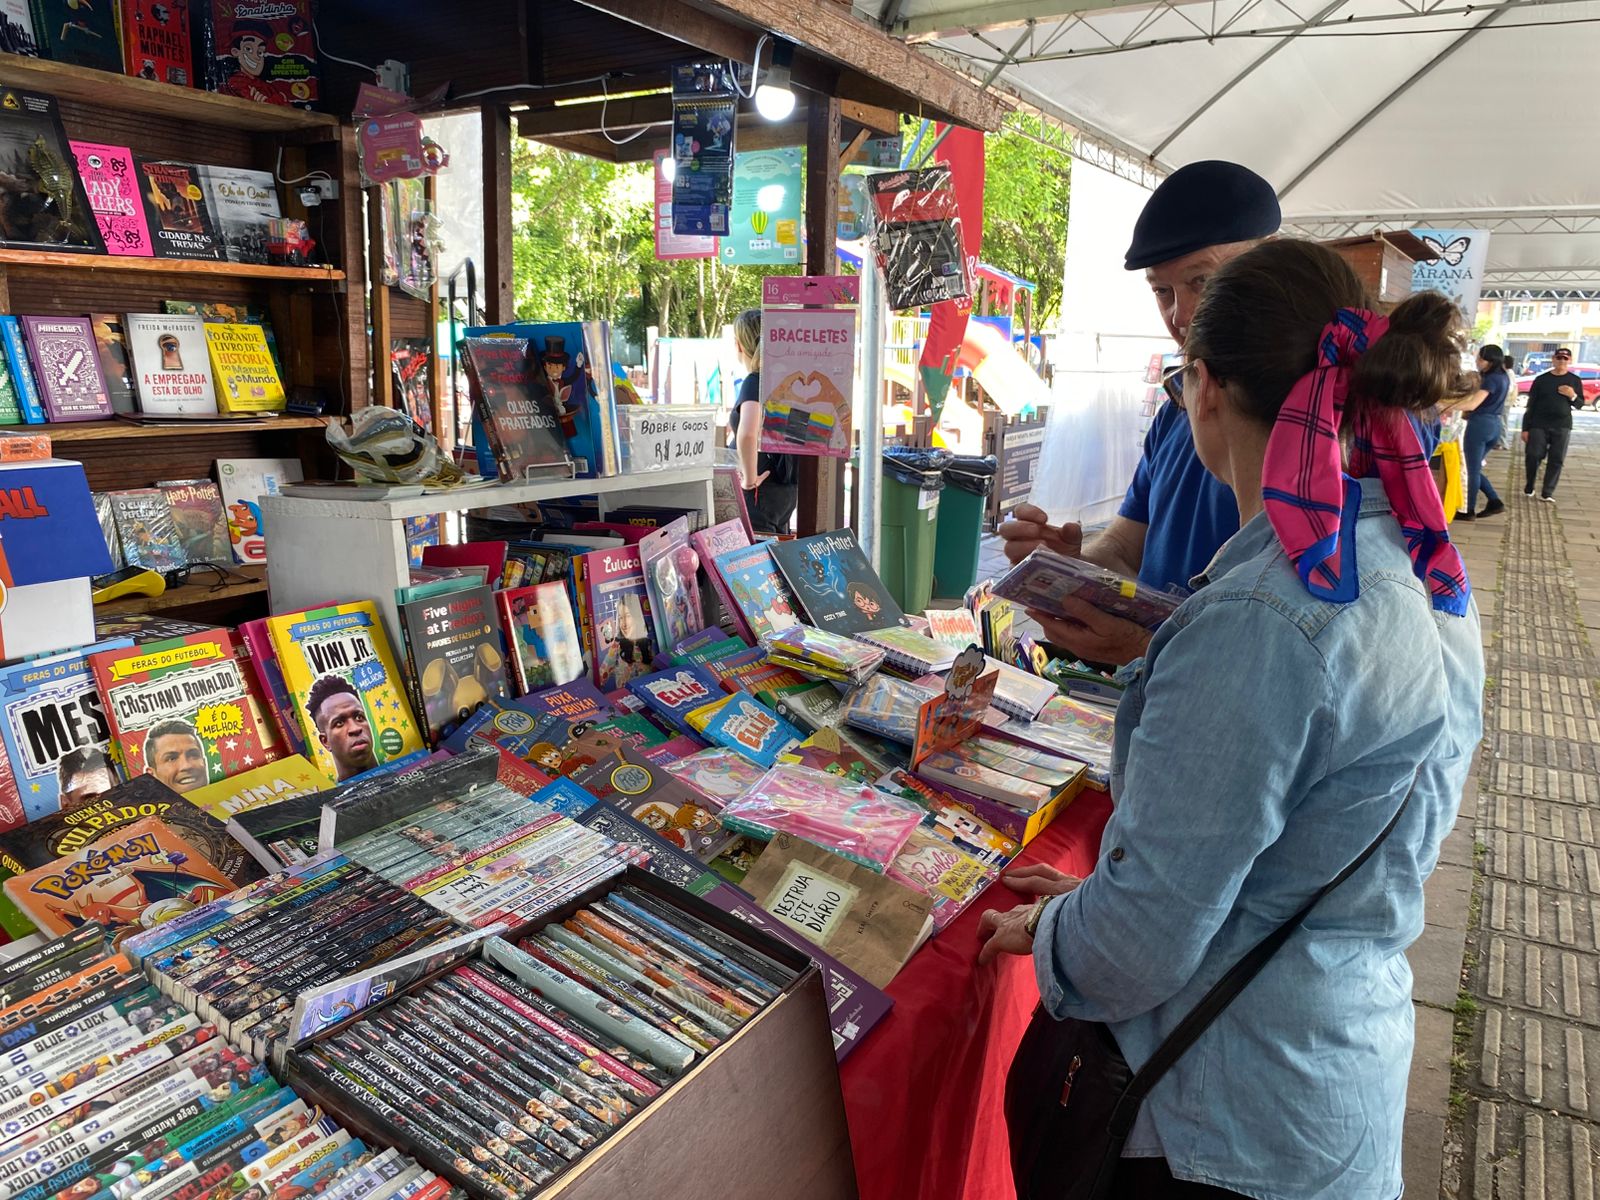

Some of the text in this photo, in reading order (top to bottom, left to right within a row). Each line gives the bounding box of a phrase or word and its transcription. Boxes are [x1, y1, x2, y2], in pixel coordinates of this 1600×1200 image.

[138, 25, 184, 48] RAPHAEL
[140, 41, 185, 63] MONTES
[81, 175, 121, 196] LADY
[158, 230, 212, 243] CIDADE NAS
[170, 239, 205, 250] TREVAS
[767, 283, 779, 296] 16
[38, 324, 83, 336] MINECRAFT
[213, 332, 261, 343] O GRANDE
[769, 328, 848, 344] BRACELETES
[214, 342, 258, 352] LIVRO DE
[218, 352, 270, 366] HISTÓRIA
[144, 374, 207, 385] A EMPREGADA
[232, 365, 270, 375] Manual
[242, 374, 277, 384] Mundo
[173, 385, 202, 395] DE OLHO
[507, 400, 541, 414] OLHOS
[499, 415, 556, 431] PRATEADOS
[641, 420, 677, 435] BOBBIE
[654, 440, 704, 461] R$ 20,00
[166, 486, 219, 506] Harry Potter
[806, 535, 854, 561] Harry Potter
[603, 552, 642, 574] Luluca
[422, 605, 447, 621] Five
[299, 617, 360, 633] FERAS DO FUTEBOL
[426, 624, 440, 636] at
[131, 648, 209, 670] FERAS DO FUTEBOL
[307, 637, 374, 674] VINI JR.
[23, 671, 50, 683] FERAS
[53, 667, 66, 676] DO
[358, 671, 384, 688] MELHOR
[367, 667, 373, 675] O
[119, 671, 235, 719] CRISTIANO RONALDO
[545, 690, 581, 707] PUXA,
[656, 682, 708, 707] ELLIE
[211, 710, 228, 723] É O
[563, 696, 597, 717] BRUXA!
[203, 718, 239, 734] MELHOR
[737, 711, 779, 750] ELLIE
[218, 778, 297, 815] MINA
[64, 805, 95, 825] QUEM
[105, 800, 114, 810] O
[57, 802, 171, 856] CULPADO?
[1, 854, 26, 875] QUEM
[911, 850, 960, 886] Barbie
[770, 870, 815, 919] DESTRUA
[789, 896, 815, 925] ESTE
[801, 887, 846, 935] DIÁRIO
[217, 914, 261, 943] Gege Akutami
[4, 941, 65, 975] YUKINOBU TATSU
[32, 968, 71, 993] HIROHIKO
[35, 966, 61, 983] ARAKI
[284, 973, 302, 988] Gege
[299, 960, 327, 979] Akutami
[44, 1001, 82, 1025] YUKINOBU
[82, 989, 106, 1005] TATSU
[33, 1030, 66, 1054] BLUE
[77, 1009, 108, 1033] LOCK
[411, 1058, 444, 1087] DEMON
[378, 1077, 410, 1105] DEMON
[393, 1069, 426, 1098] DEMON
[174, 1102, 198, 1122] Gege
[359, 1088, 392, 1118] DEMON
[18, 1102, 53, 1129] BLUE
[140, 1114, 177, 1142] Akutami
[38, 1130, 75, 1158] BLUE
[112, 1139, 132, 1155] 4
[54, 1141, 90, 1169] BLUE
[382, 1161, 398, 1178] 22
[3, 1166, 41, 1195] LOCK
[403, 1180, 418, 1196] 35
